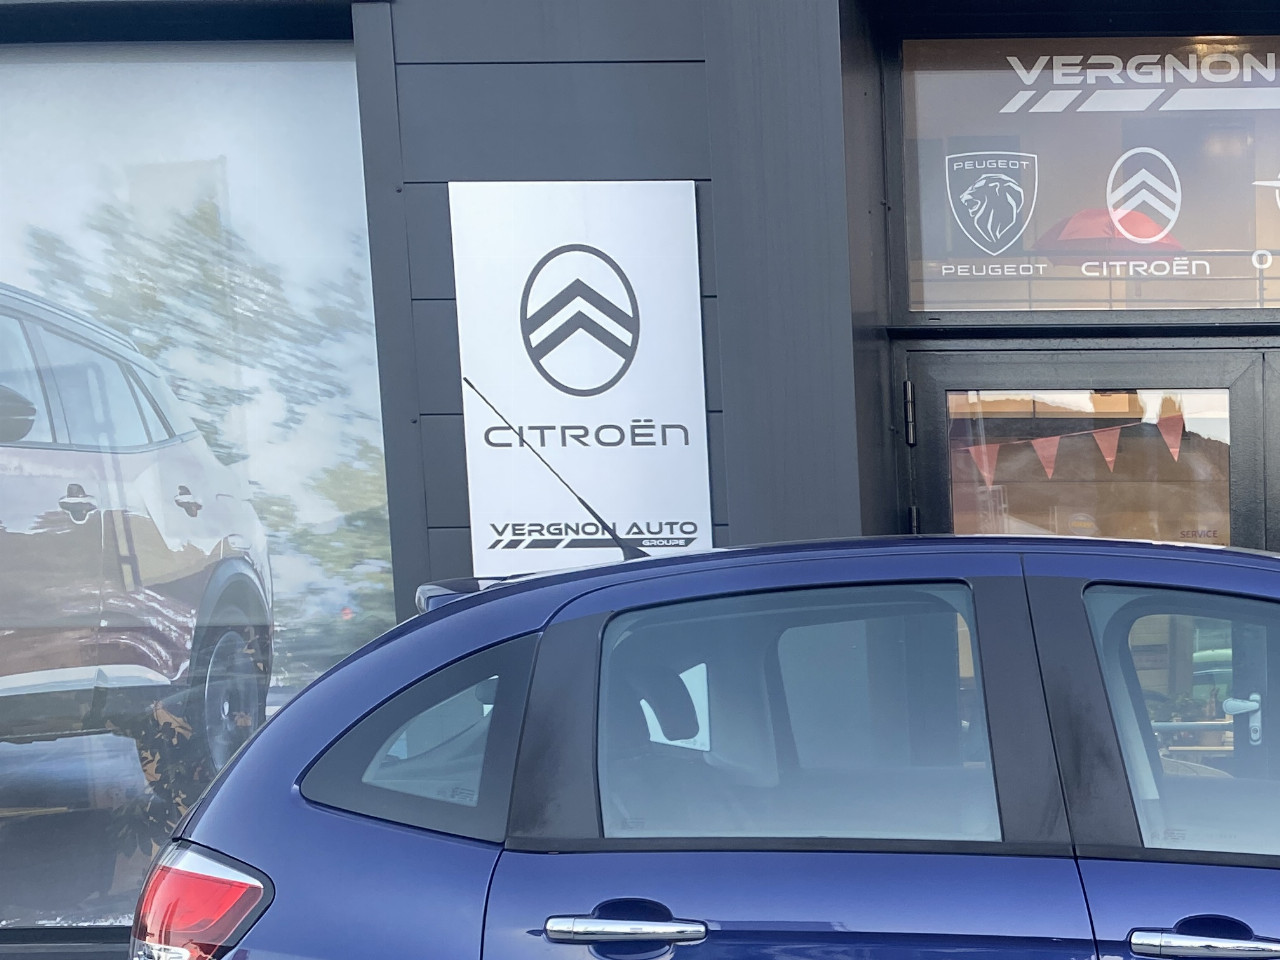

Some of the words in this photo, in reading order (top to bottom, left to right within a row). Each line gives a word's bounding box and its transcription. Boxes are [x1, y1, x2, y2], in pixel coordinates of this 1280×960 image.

[1006, 52, 1276, 85] VERGNON
[953, 159, 1029, 171] PEUGEOT
[942, 264, 1047, 276] PEUGEOT
[490, 522, 616, 537] VERGNON
[625, 521, 698, 535] AUTO
[1180, 530, 1218, 539] SERVICE
